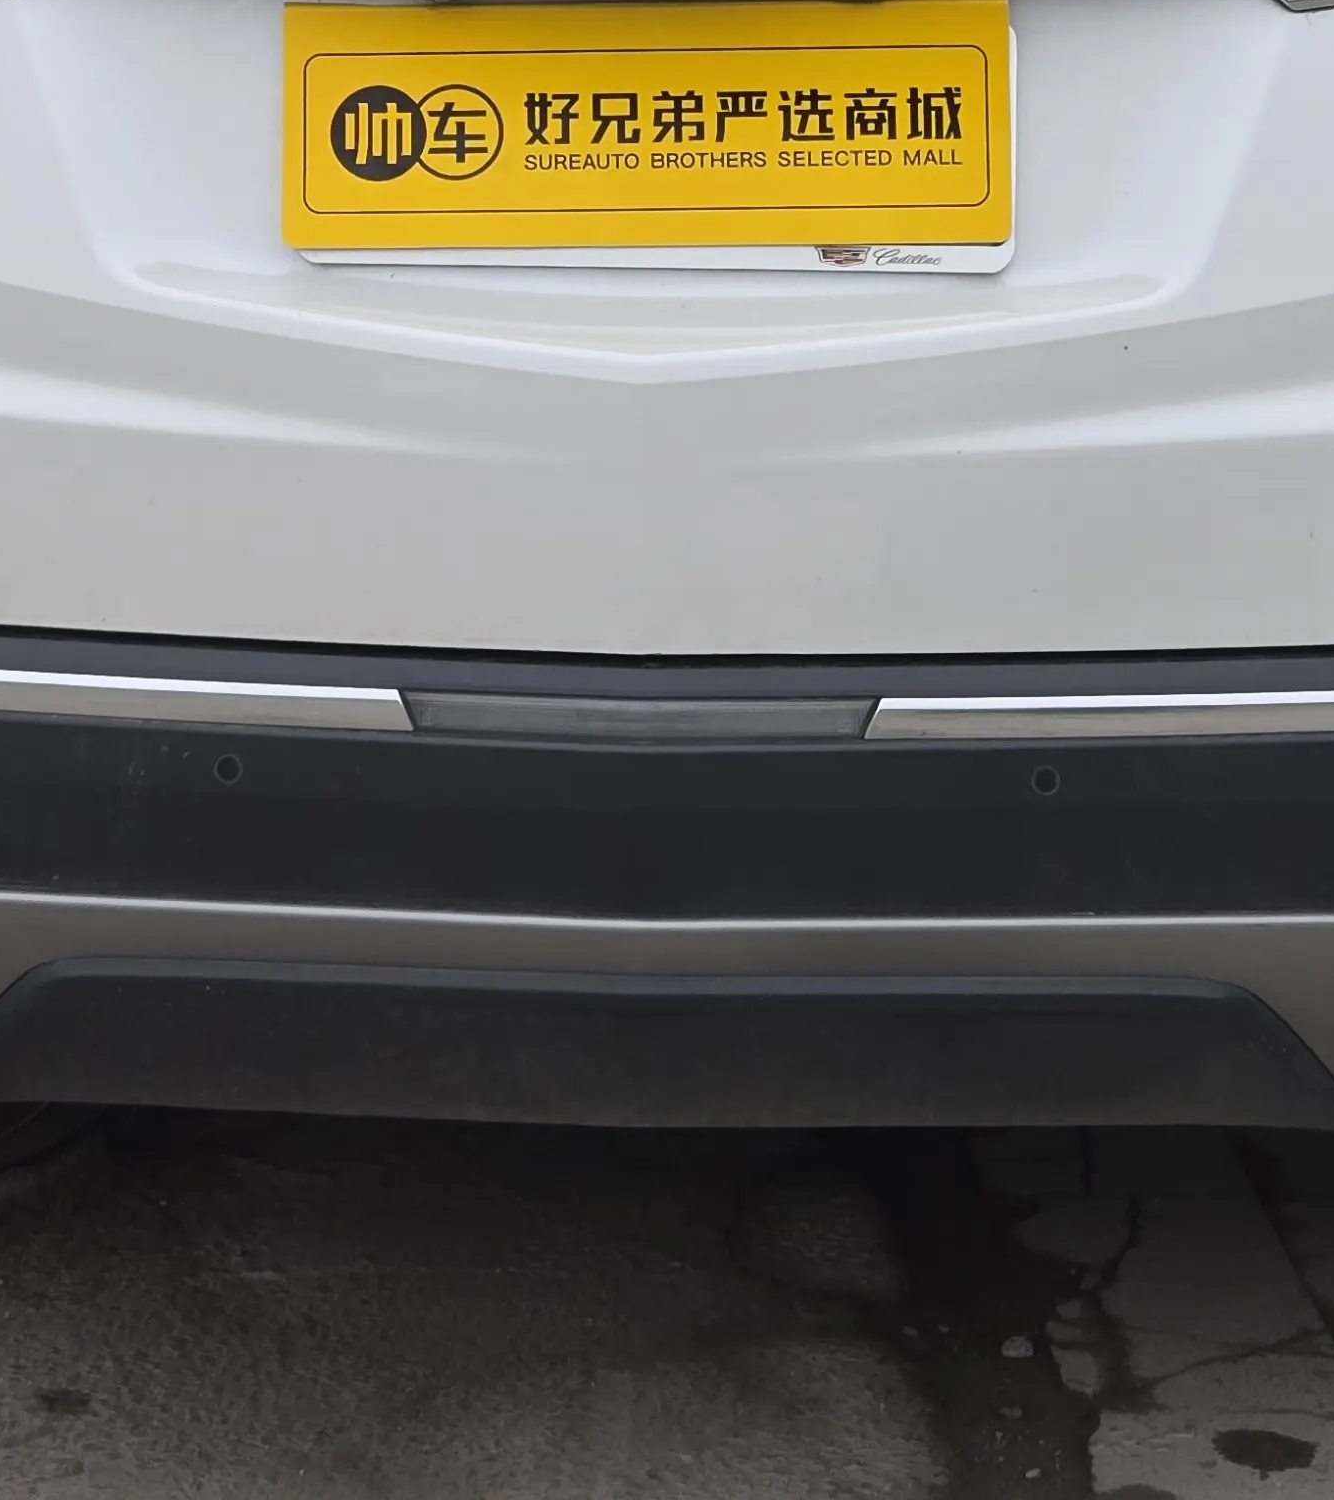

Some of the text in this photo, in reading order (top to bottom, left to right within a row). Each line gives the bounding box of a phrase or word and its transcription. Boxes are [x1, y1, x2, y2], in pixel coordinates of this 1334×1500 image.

[524, 86, 962, 147] 好兄弟严选商城
[524, 149, 963, 171] SUREAUTO BROTHERS SELECTED MALL
[872, 248, 943, 267] Cadillac
